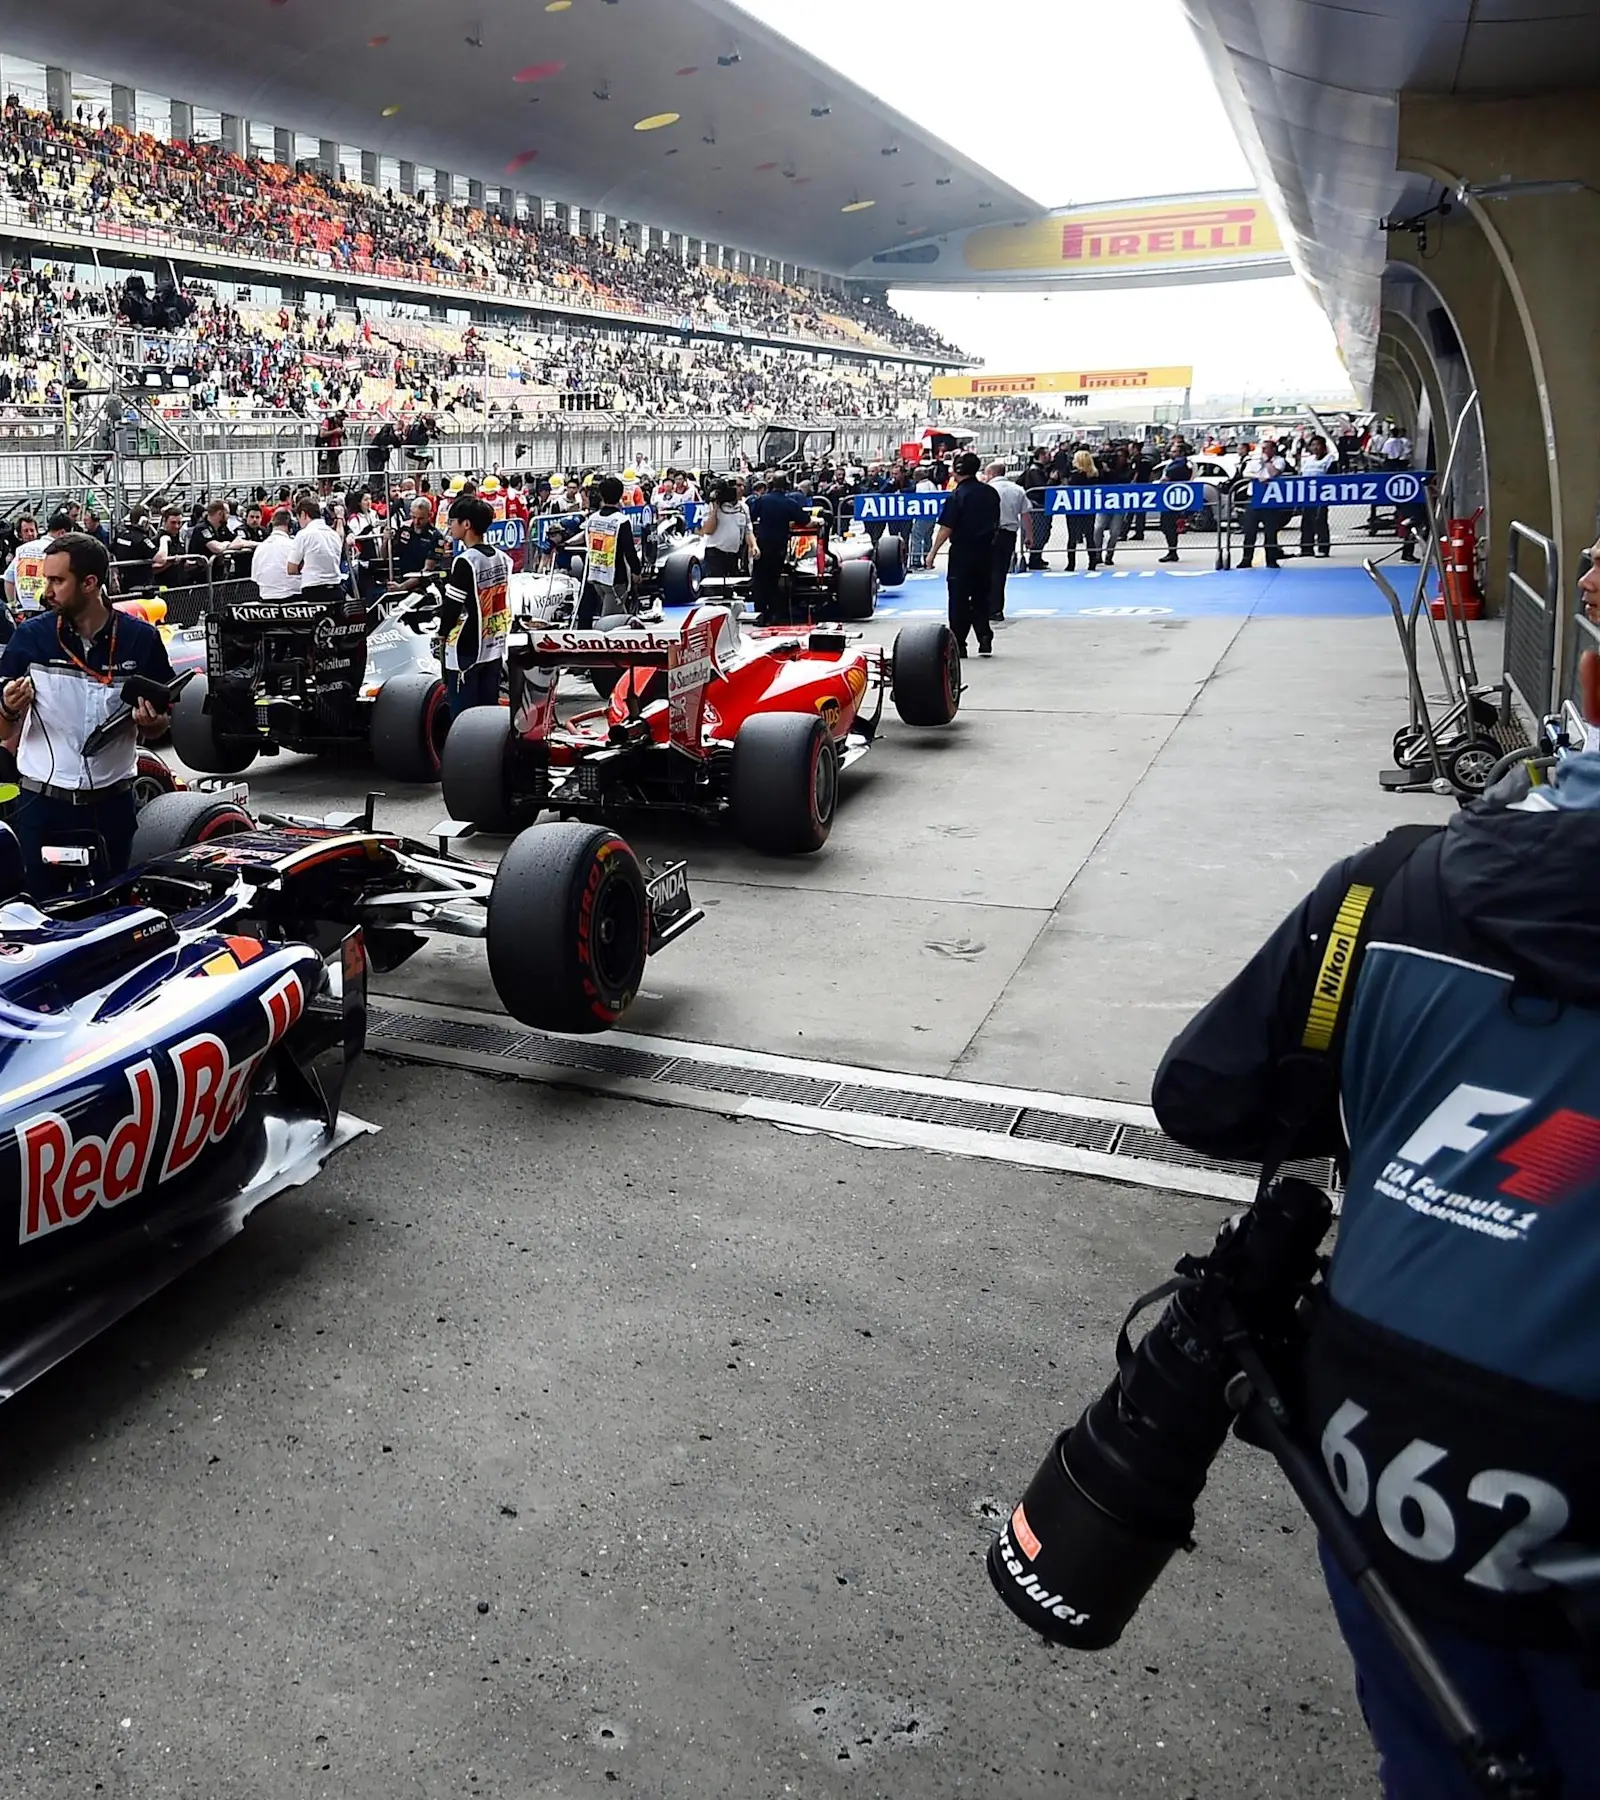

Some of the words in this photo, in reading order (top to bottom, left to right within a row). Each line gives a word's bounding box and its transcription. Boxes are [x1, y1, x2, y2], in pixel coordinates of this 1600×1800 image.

[1062, 208, 1257, 260] PIRELLI
[971, 377, 1036, 392] PIRELLI
[1080, 372, 1148, 388] PIRELLI
[1052, 490, 1156, 512] Allianz
[1262, 482, 1377, 503] Allianz
[208, 622, 224, 677] HYPE
[563, 632, 680, 651] Santander
[1320, 938, 1350, 999] Nikon
[18, 1059, 160, 1245] Red
[1382, 1162, 1415, 1188] FIA
[1411, 1176, 1515, 1223] Formula
[1512, 1212, 1538, 1231] 1
[1320, 1397, 1572, 1592] 662
